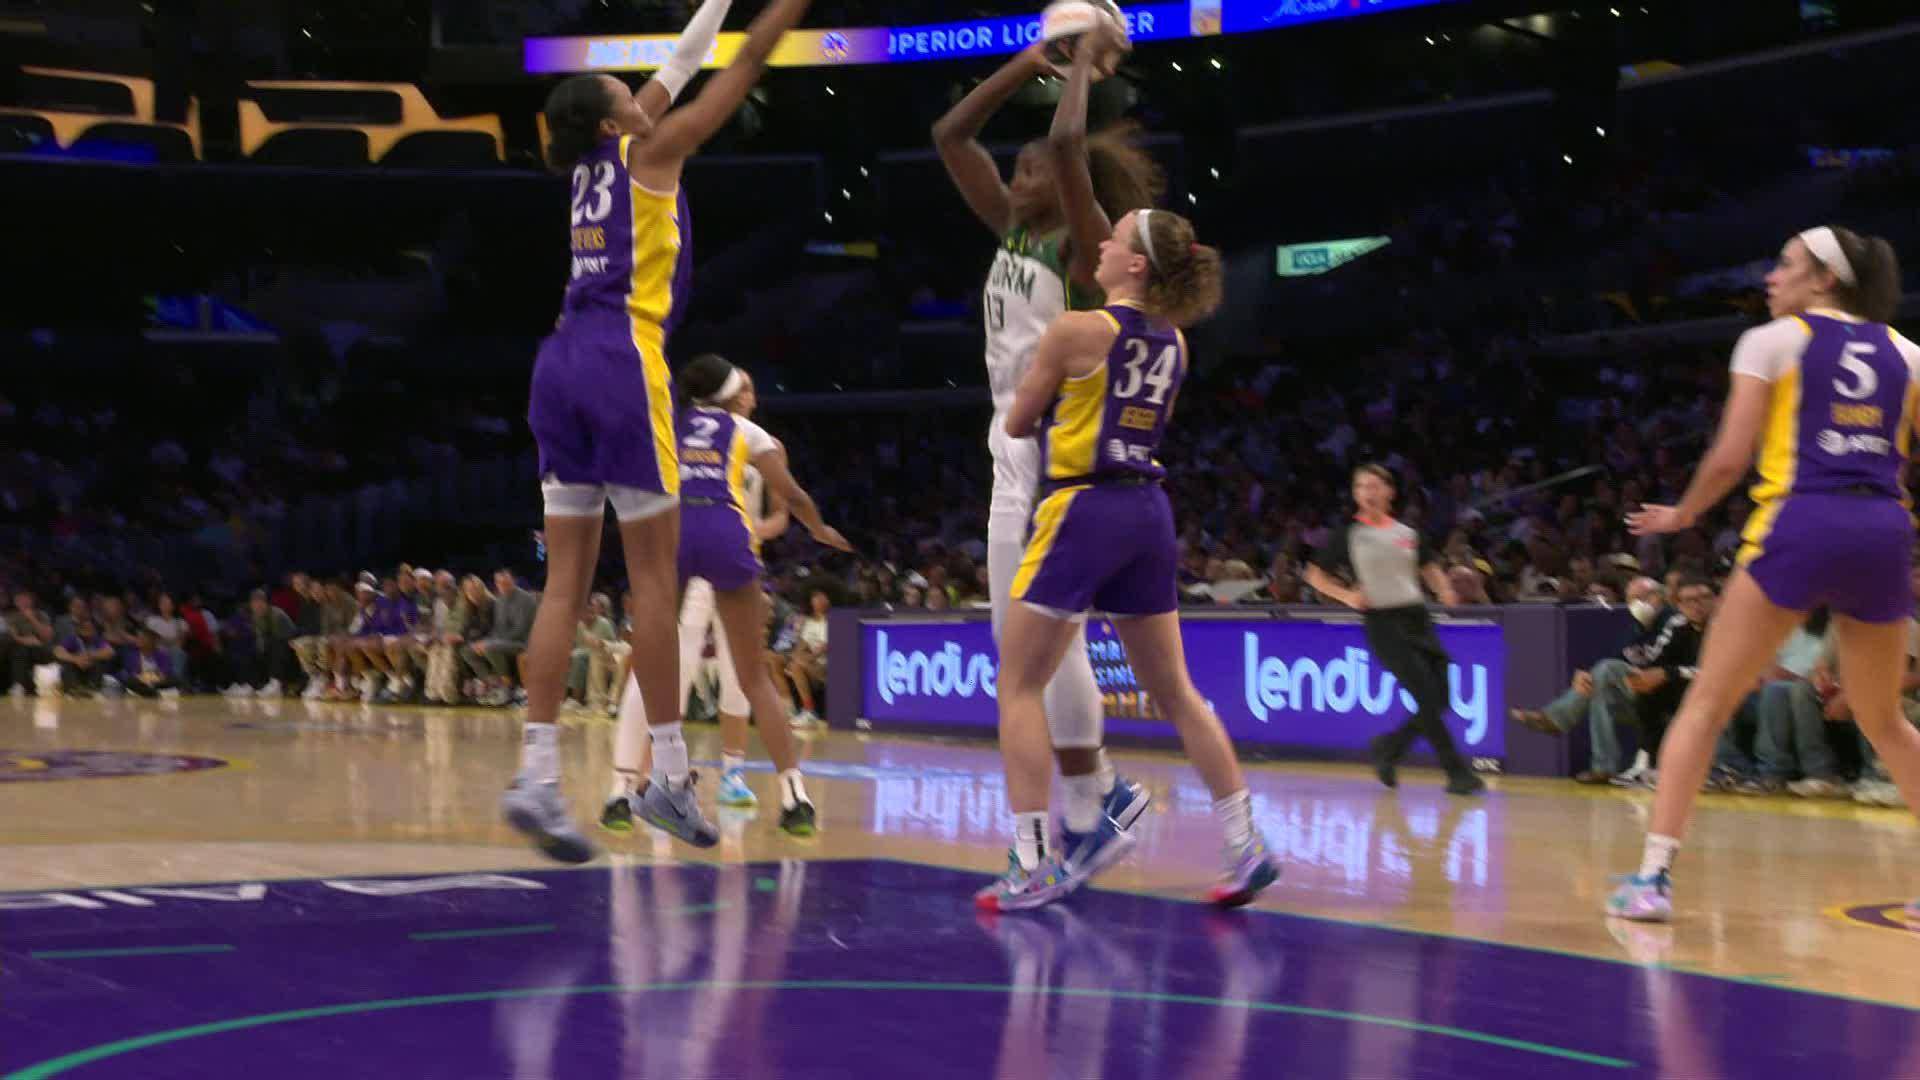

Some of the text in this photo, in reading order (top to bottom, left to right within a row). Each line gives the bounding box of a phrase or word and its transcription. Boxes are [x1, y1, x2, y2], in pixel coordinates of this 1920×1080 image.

[571, 162, 616, 226] 23
[1114, 338, 1177, 404] 34
[1831, 341, 1878, 400] 5
[682, 416, 719, 449] 2
